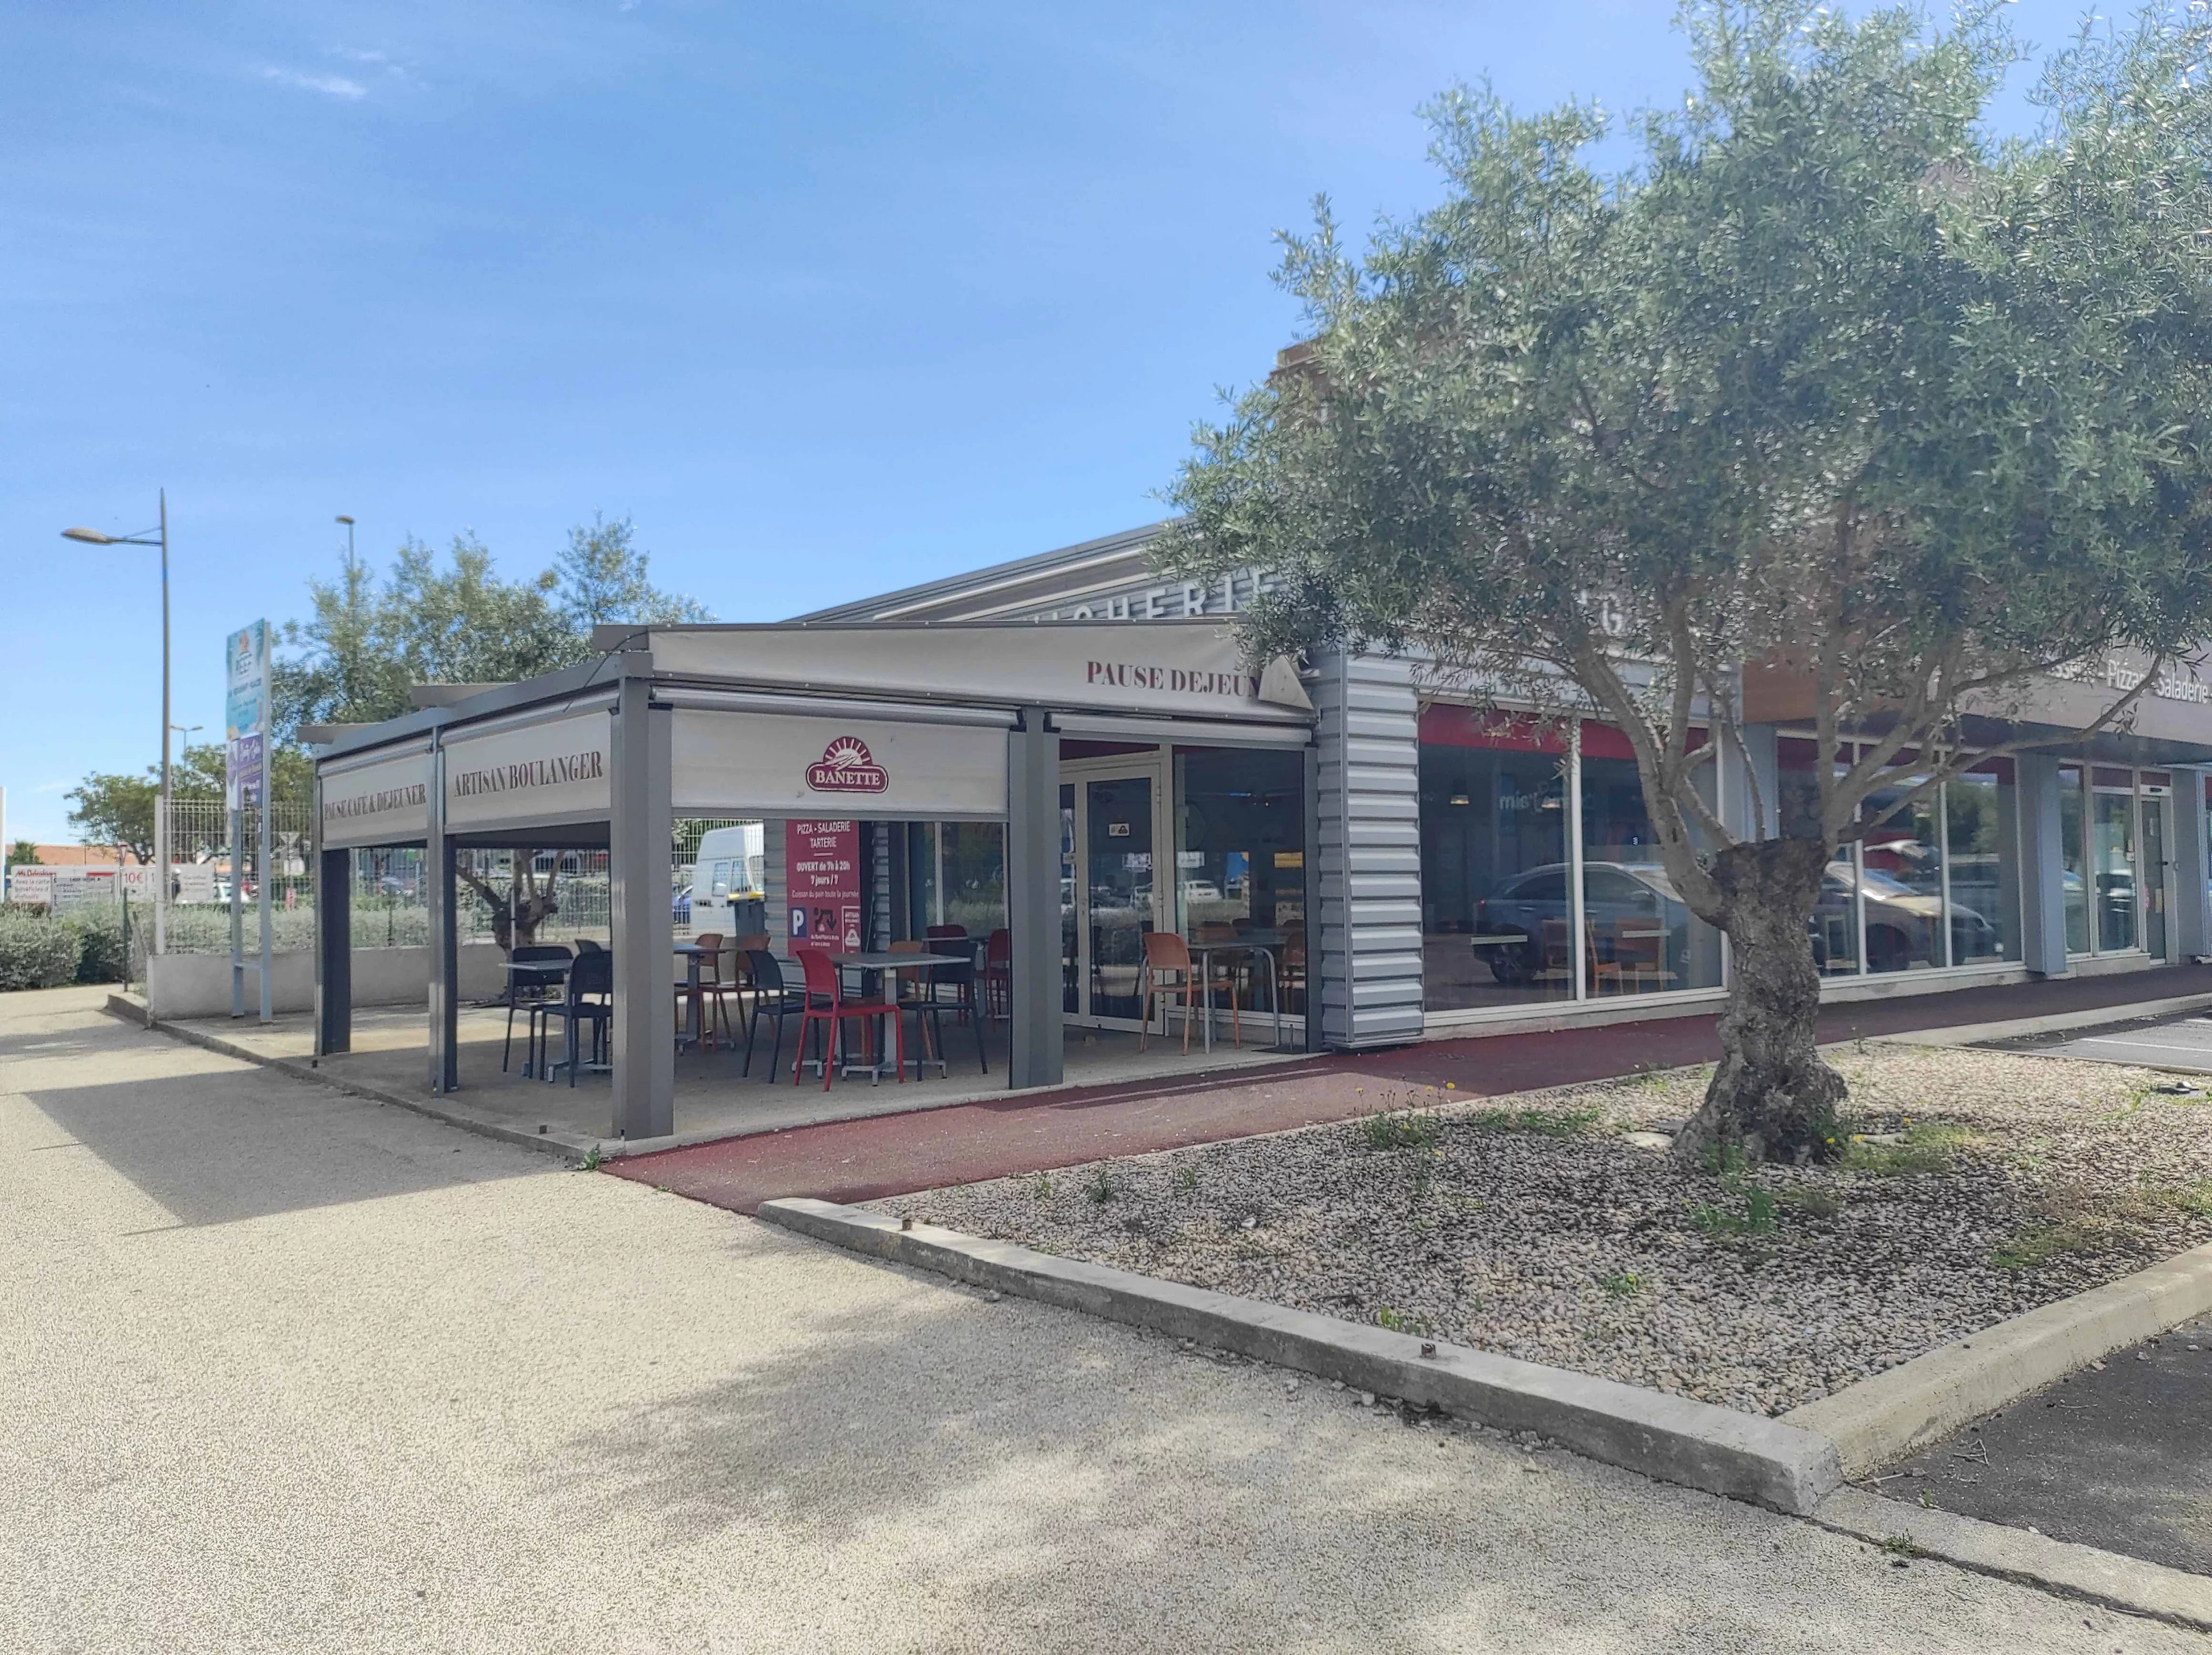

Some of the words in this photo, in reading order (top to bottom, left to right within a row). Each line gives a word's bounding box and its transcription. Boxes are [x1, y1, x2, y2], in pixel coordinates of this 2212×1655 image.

[1087, 661, 1164, 690] PAUSE
[2156, 669, 2208, 704] Saladerie
[454, 767, 505, 798] ARTISAN
[509, 751, 604, 790] BOULANGER
[815, 770, 881, 786] BANETTE
[324, 799, 347, 821] PAUSE
[369, 794, 376, 813] &
[797, 823, 813, 835] PIZZA
[818, 820, 851, 833] SALADERIE
[810, 836, 837, 848] TARTERIE
[797, 861, 819, 872] OUVERT
[819, 861, 827, 871] de
[835, 860, 839, 870] à
[839, 860, 850, 871] 20h
[124, 872, 144, 884] 10€
[811, 875, 815, 885] 7
[815, 875, 830, 887] jours
[793, 909, 804, 935] P
